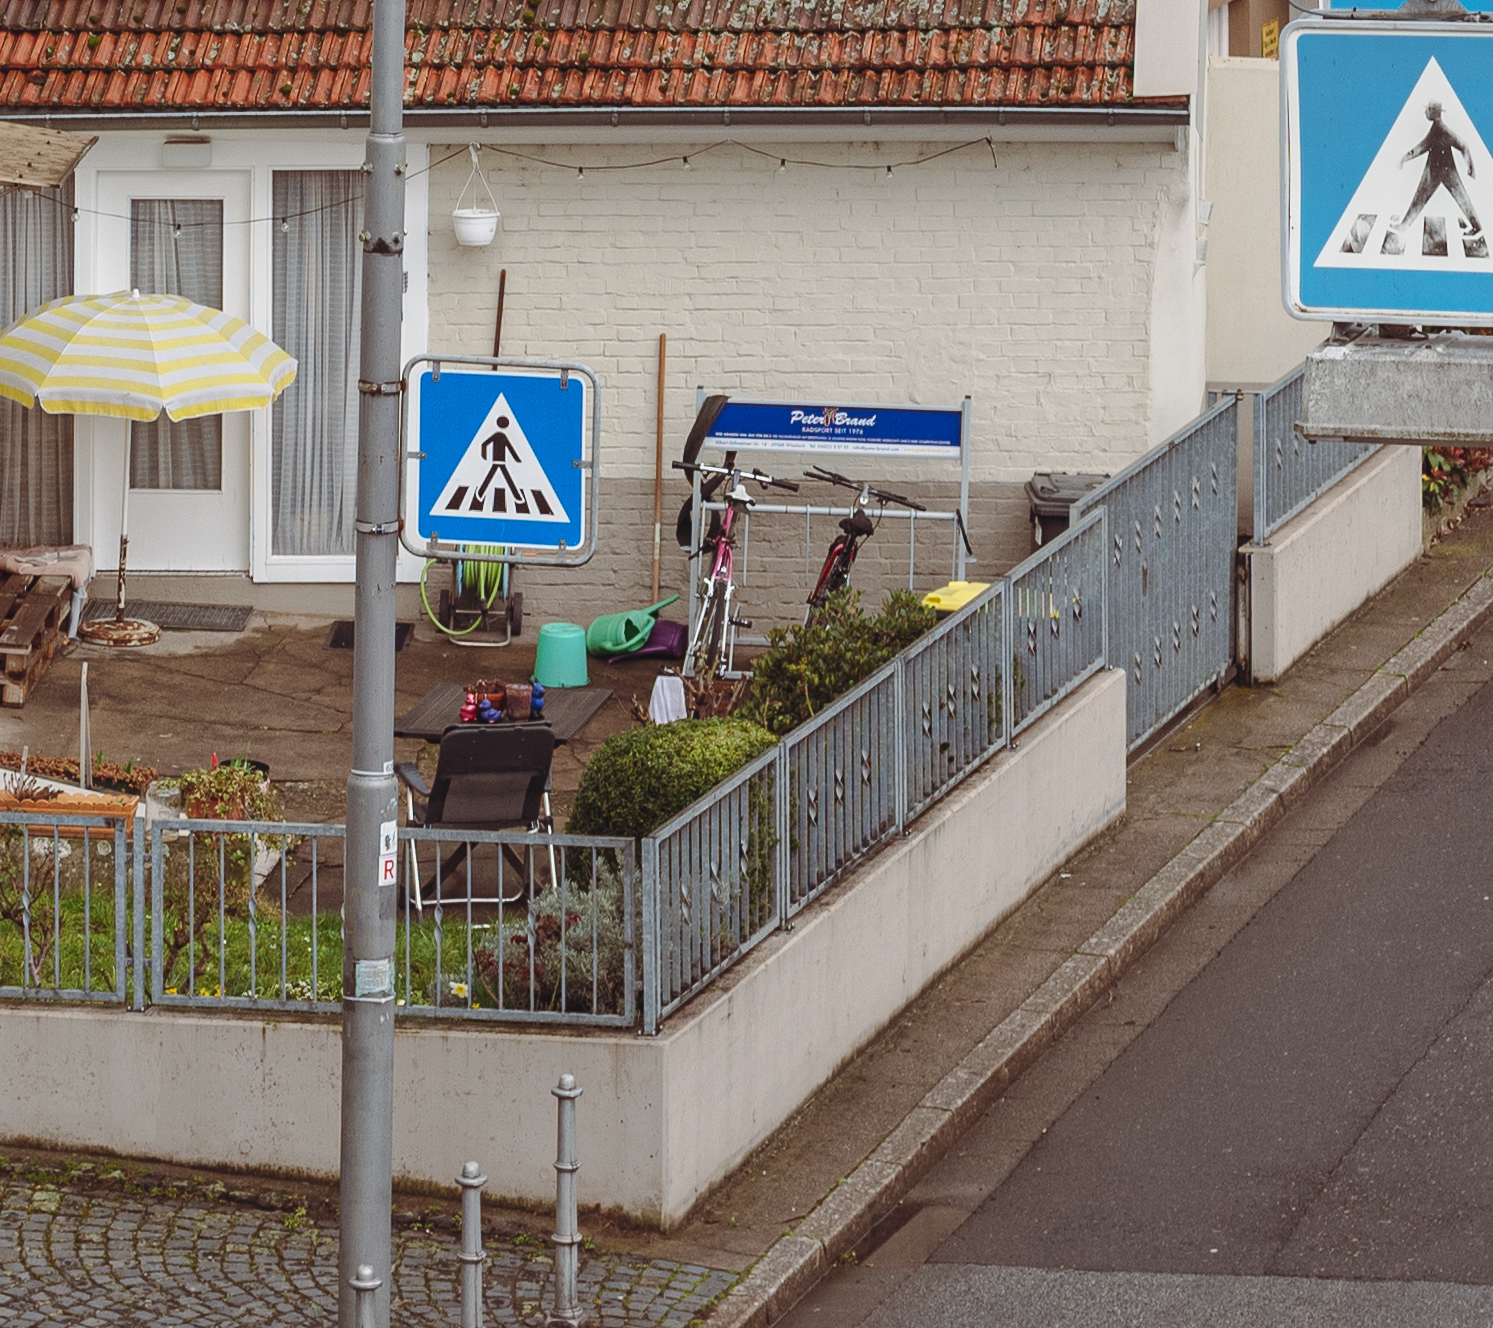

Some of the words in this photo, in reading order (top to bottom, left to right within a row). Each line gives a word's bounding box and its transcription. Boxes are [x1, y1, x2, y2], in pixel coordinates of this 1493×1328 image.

[790, 410, 825, 425] Peter
[835, 412, 877, 427] Brand
[801, 426, 833, 434] RADSPORT
[834, 427, 847, 435] SEIT
[383, 859, 395, 881] R
